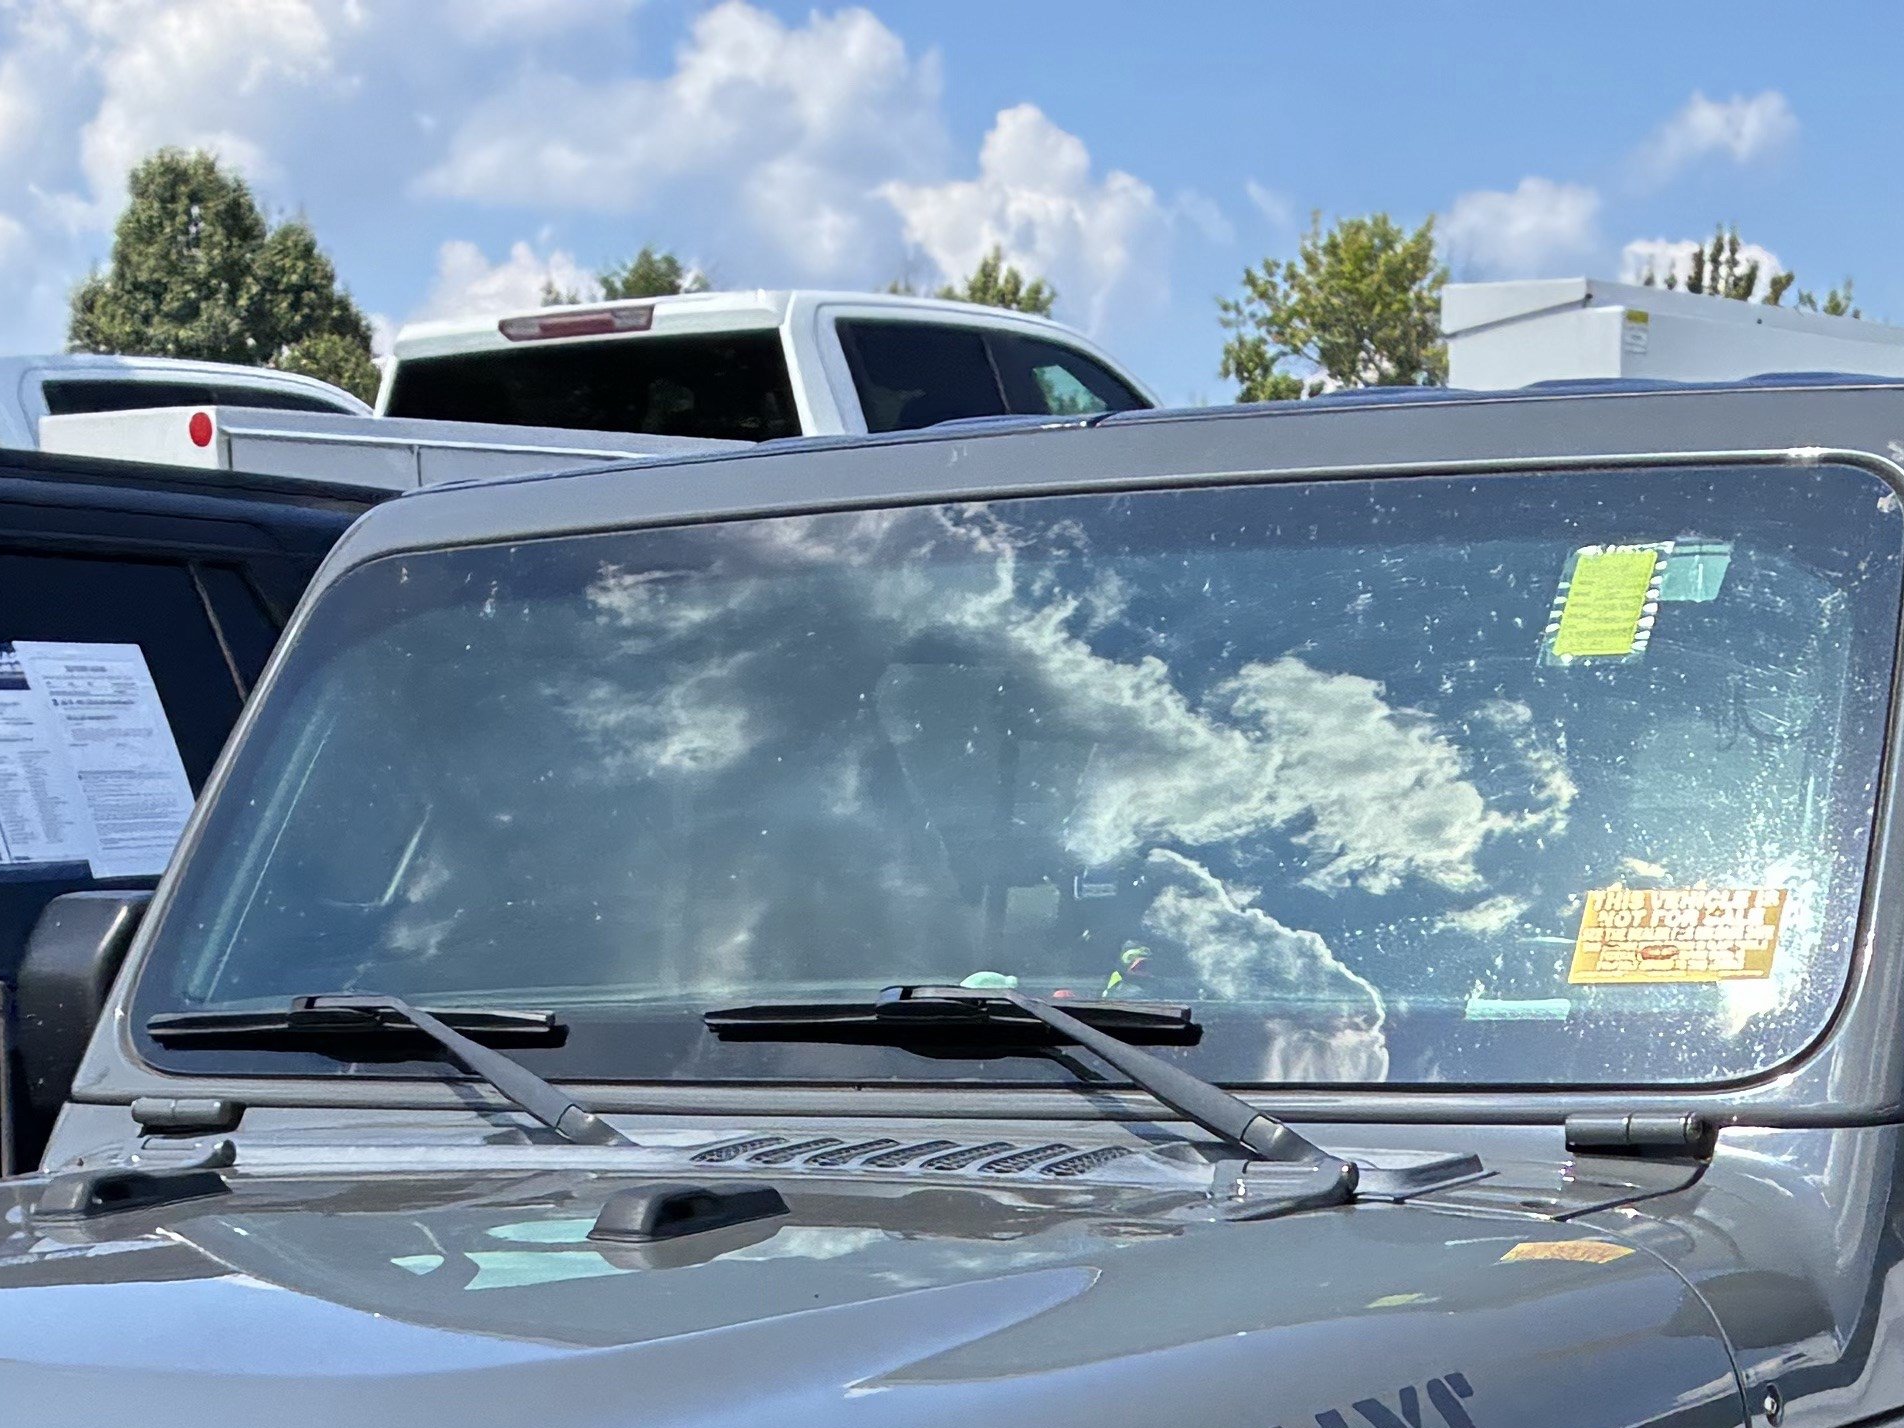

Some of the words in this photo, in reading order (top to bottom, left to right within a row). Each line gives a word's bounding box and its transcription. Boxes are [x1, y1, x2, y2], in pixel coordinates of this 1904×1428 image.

[1593, 890, 1646, 911] THIS
[1597, 908, 1647, 928] NOT
[1650, 908, 1699, 928] FOR
